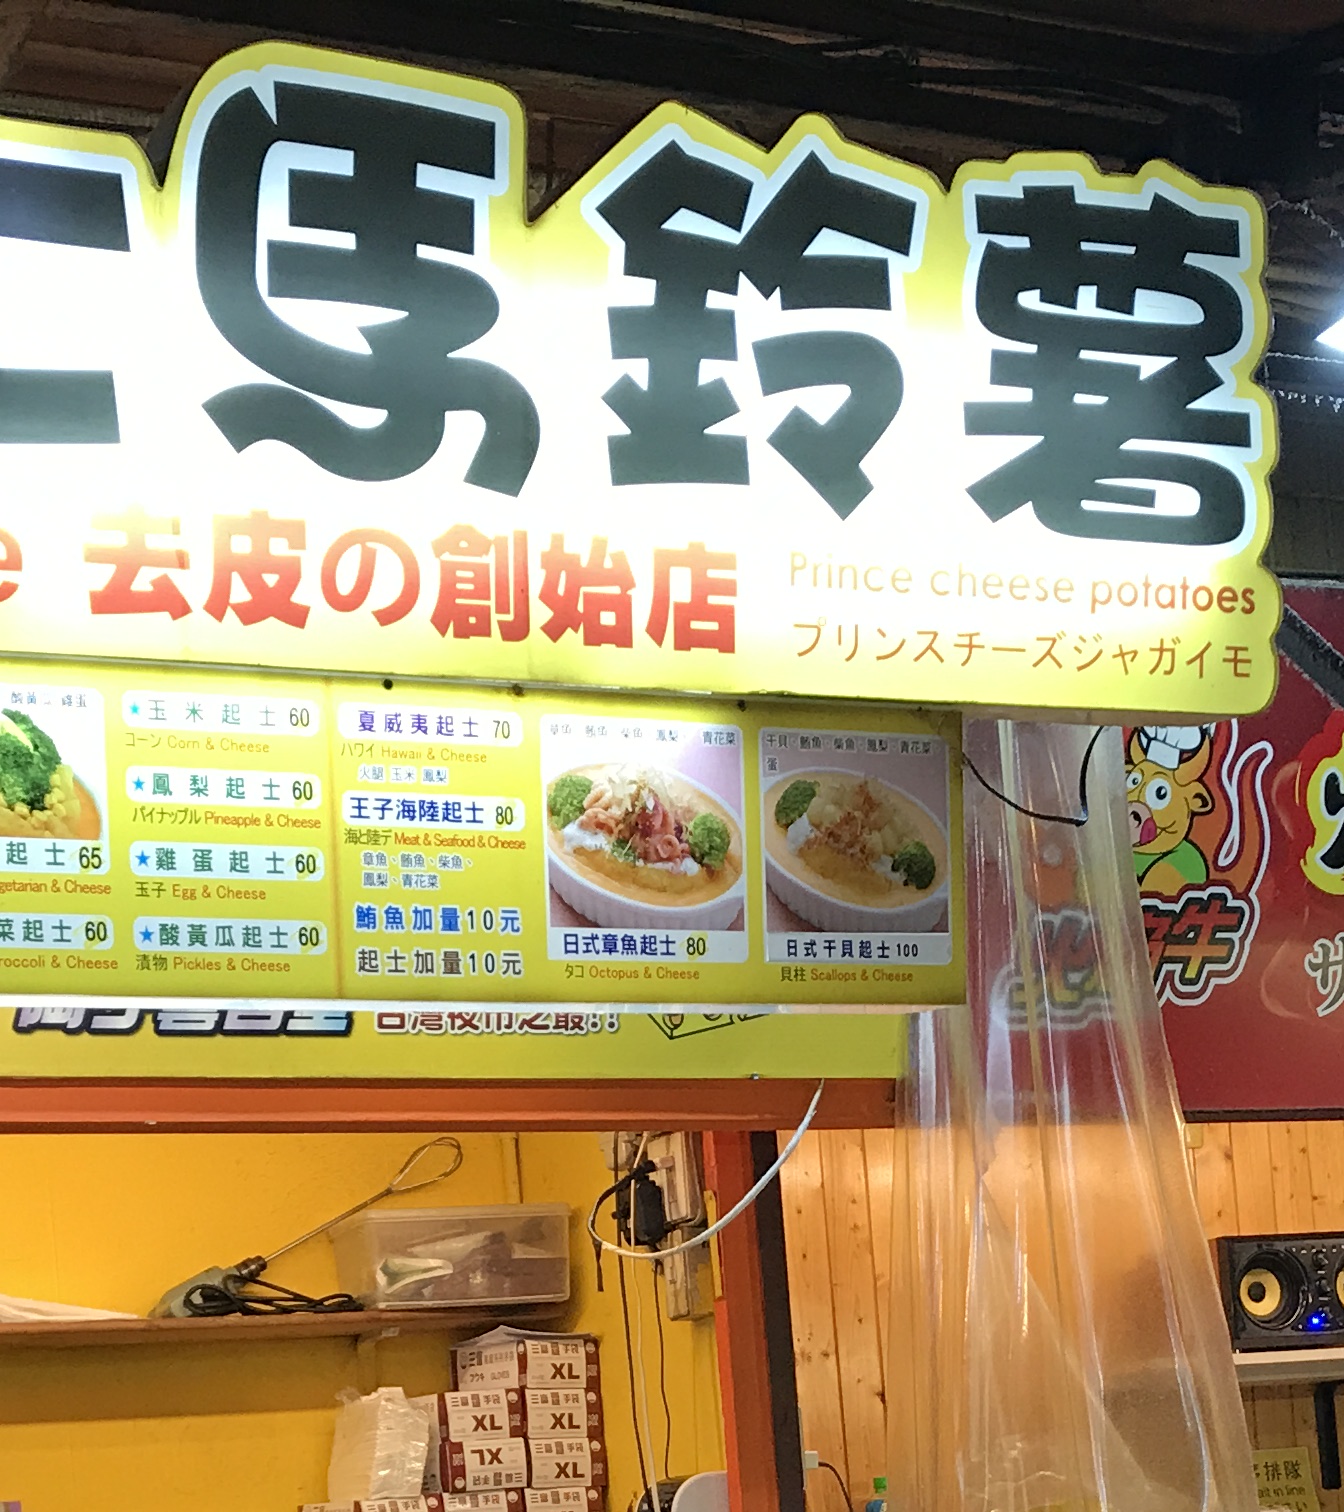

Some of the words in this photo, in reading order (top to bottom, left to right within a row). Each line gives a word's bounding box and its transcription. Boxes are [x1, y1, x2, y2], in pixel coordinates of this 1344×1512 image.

[84, 508, 738, 655] 去皮の創始店
[790, 551, 912, 593] Prince
[931, 568, 1074, 603] cheese
[1091, 575, 1256, 615] potatoes
[793, 616, 1252, 679] プリンスチーズジャガイモ
[148, 699, 276, 727] 玉米起士
[289, 707, 310, 728] 60
[358, 710, 479, 738] 夏威夷起士
[493, 720, 511, 739] 70
[125, 732, 161, 748] コーン
[167, 735, 201, 750] Corn
[219, 738, 270, 753] Cheese
[703, 731, 736, 745] 青花菜
[341, 743, 375, 758] ハワイ
[381, 746, 422, 759] Hawaii
[441, 749, 487, 763] Cheese
[152, 773, 281, 801] 鳳梨起士
[292, 780, 313, 801] 60
[133, 807, 202, 825] パイナップル
[205, 811, 261, 830] Pineapple
[277, 814, 321, 829] Cheese
[350, 797, 484, 824] 王子海陸起士
[495, 805, 513, 825] 80
[394, 832, 422, 846] Meat
[434, 833, 476, 848] Seafood
[488, 835, 526, 849] Cheese
[79, 846, 101, 869] 65
[156, 846, 285, 875] 雞蛋起士
[295, 854, 317, 874] 60
[64, 878, 111, 895] Cheese
[135, 883, 167, 899] 玉子
[172, 885, 197, 901] Egg
[216, 886, 266, 900] Cheese
[354, 903, 522, 936] 鮪魚加量10元
[84, 921, 107, 943] 60
[158, 923, 289, 950] 酸黃瓜起士
[298, 926, 320, 947] 60
[563, 934, 677, 957] 日式章魚起士
[686, 936, 707, 957] 80
[786, 939, 890, 959] 日式干貝起士
[896, 941, 919, 959] 100
[66, 954, 118, 970] Cheese
[135, 954, 168, 972] 漬物
[173, 957, 222, 972] Pickles
[241, 958, 291, 973] Cheese
[356, 948, 523, 979] 起士加量10元
[564, 967, 585, 980] タコ
[589, 967, 639, 982] Octopus
[657, 968, 700, 981] Cheese
[780, 967, 807, 983] 貝柱
[810, 968, 857, 984] Scallops
[872, 970, 913, 983] Cheese
[550, 1363, 580, 1380] XL
[471, 1414, 503, 1432] XL
[550, 1413, 581, 1430] XL
[470, 1447, 504, 1466] XL
[554, 1461, 585, 1480] XL
